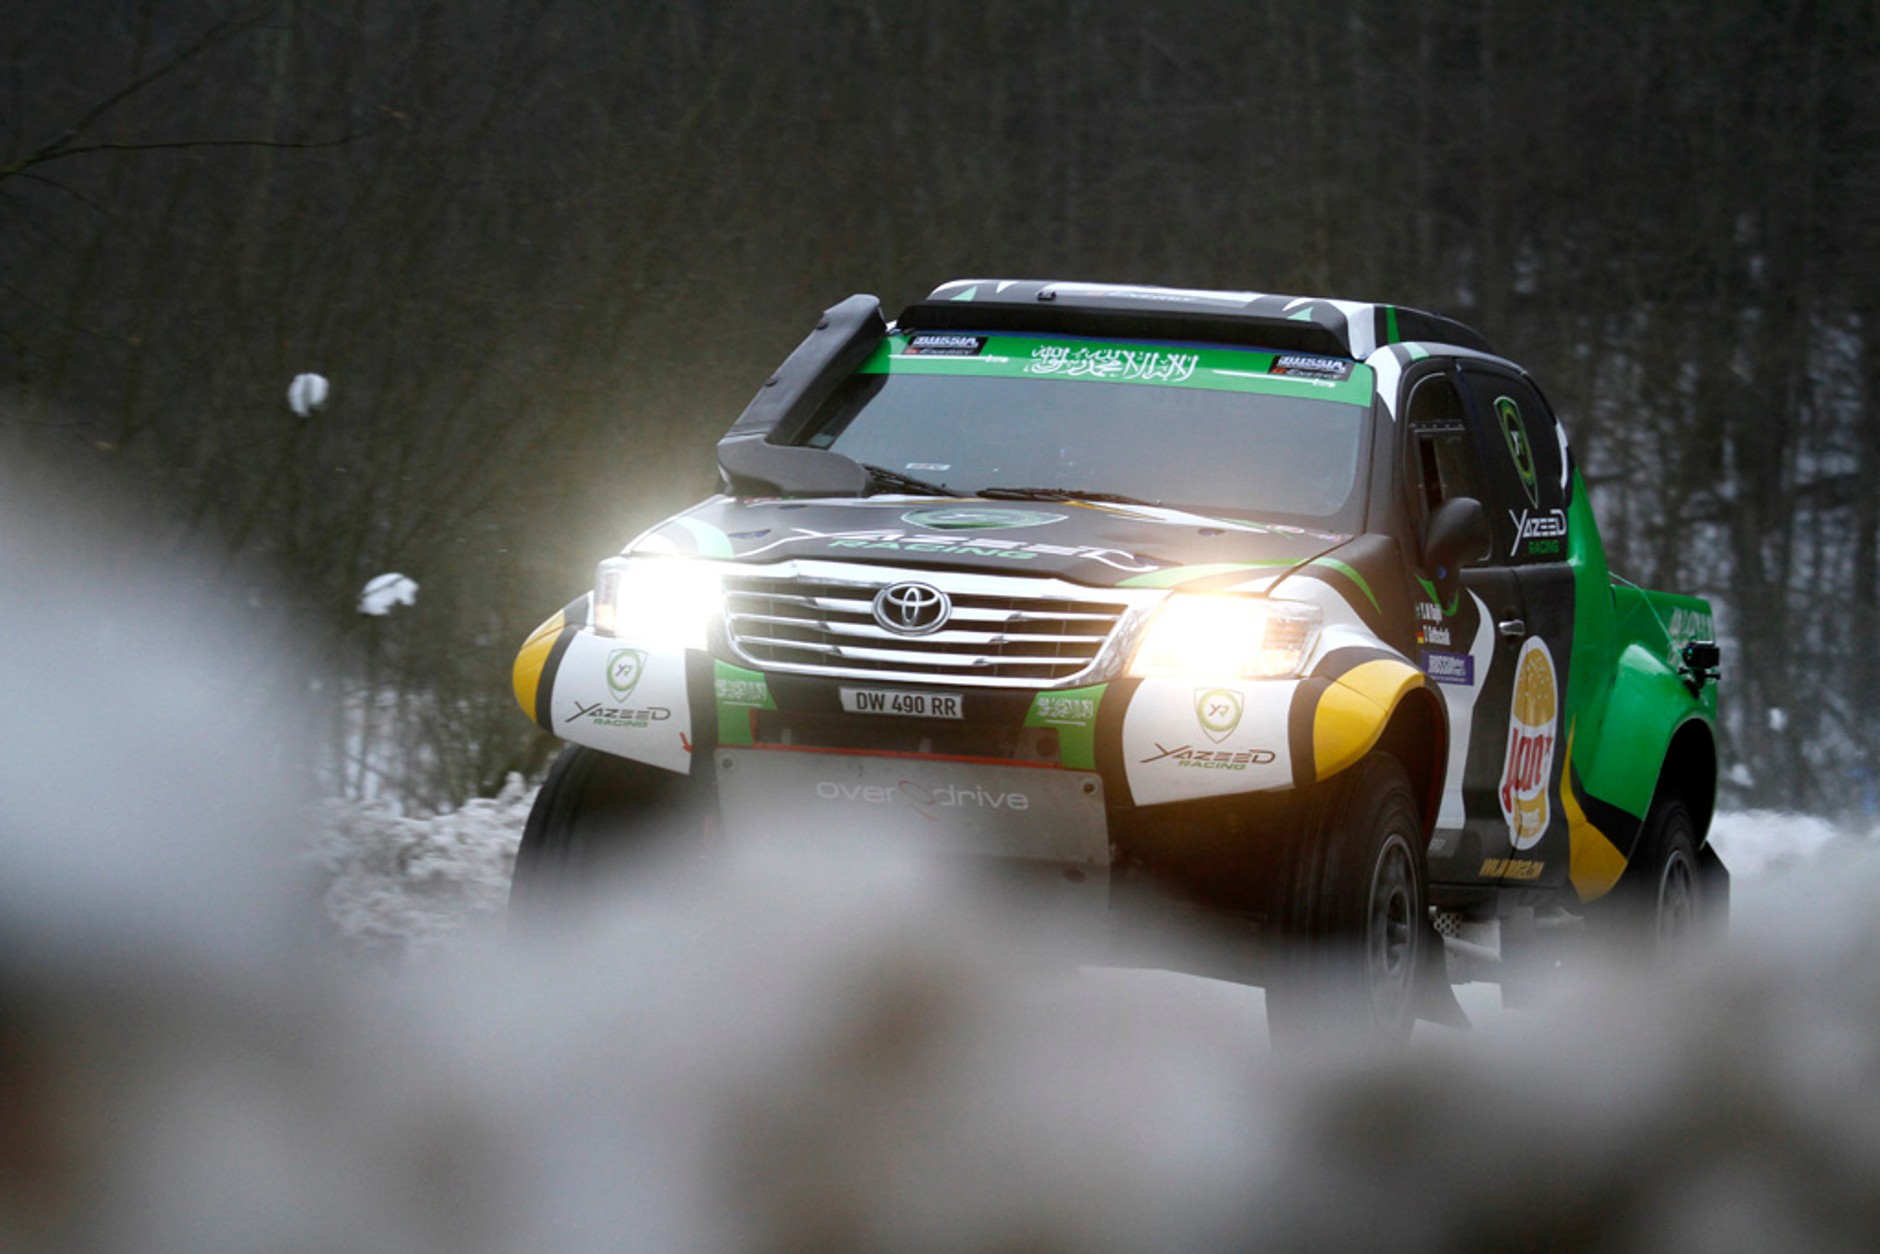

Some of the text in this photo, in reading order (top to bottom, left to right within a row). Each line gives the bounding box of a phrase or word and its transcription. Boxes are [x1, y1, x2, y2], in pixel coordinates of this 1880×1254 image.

[1508, 508, 1568, 557] YAZEED
[827, 539, 1038, 560] RACING
[564, 700, 671, 723] YAZEED
[856, 692, 956, 717] DW 490 RR
[593, 718, 648, 729] RACING
[1140, 742, 1276, 765] YAZEED
[1178, 760, 1247, 771] RACING
